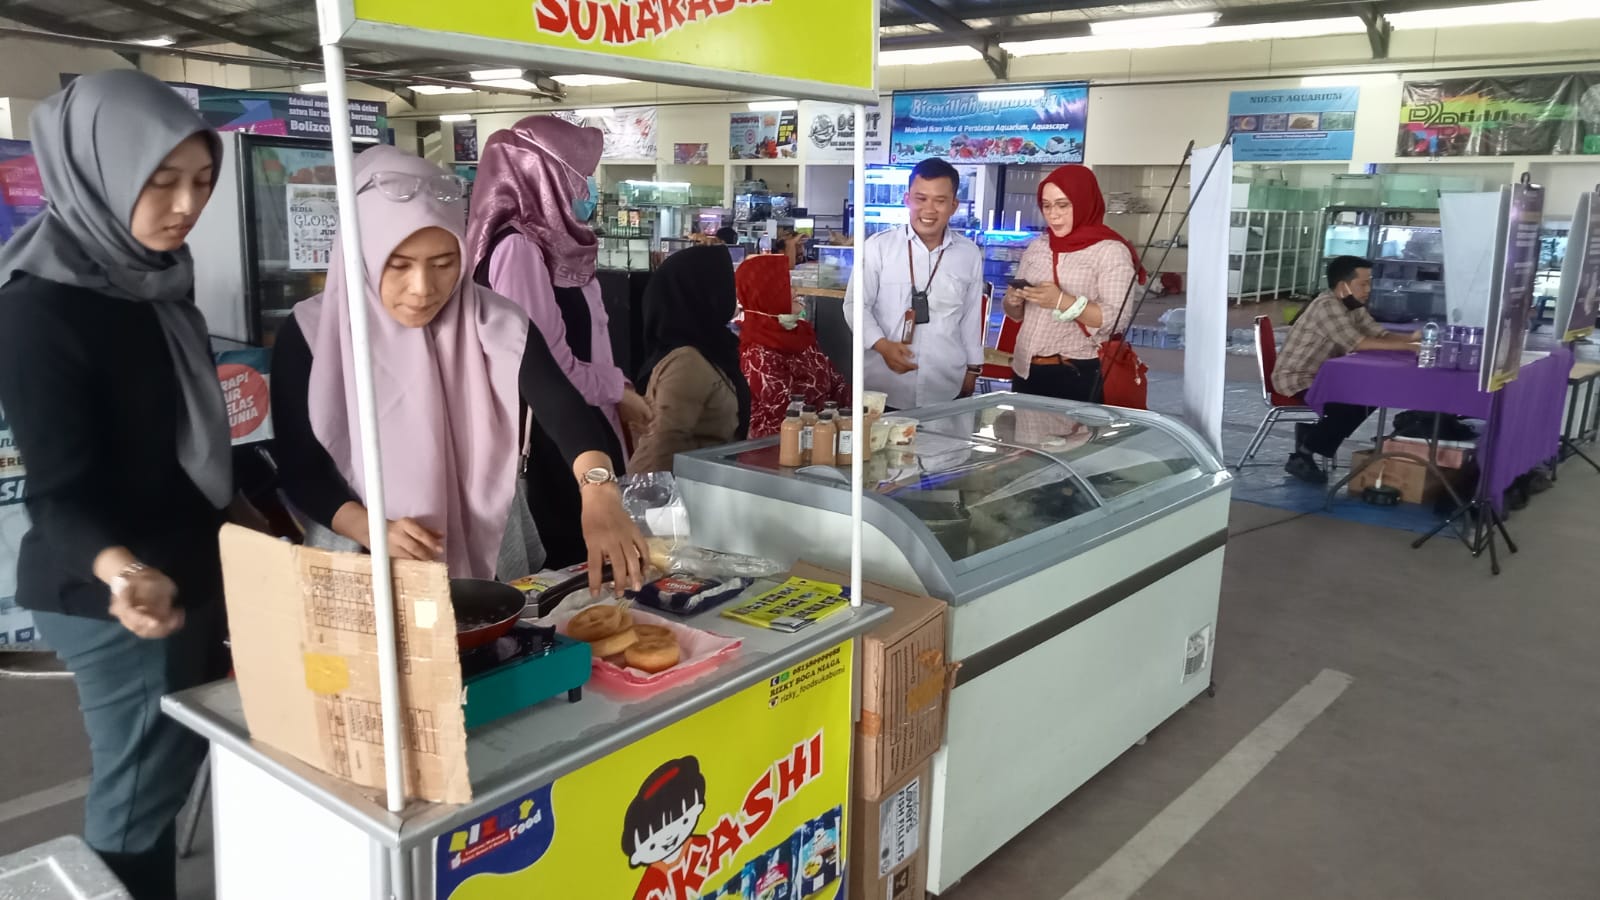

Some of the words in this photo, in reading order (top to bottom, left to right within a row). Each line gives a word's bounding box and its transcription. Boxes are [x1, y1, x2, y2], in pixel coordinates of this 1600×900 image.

[535, 0, 772, 44] SUMAKA
[355, 124, 379, 137] Kibo
[220, 372, 249, 391] RAPI
[226, 395, 255, 416] ELAS
[229, 406, 259, 427] UNIA
[0, 480, 26, 501] SI
[770, 681, 794, 698] RIZKY
[795, 670, 816, 685] BOGA
[817, 658, 841, 673] NIAGA
[897, 790, 905, 817] FISH
[508, 808, 542, 841] Food
[897, 818, 905, 863] FILLETS
